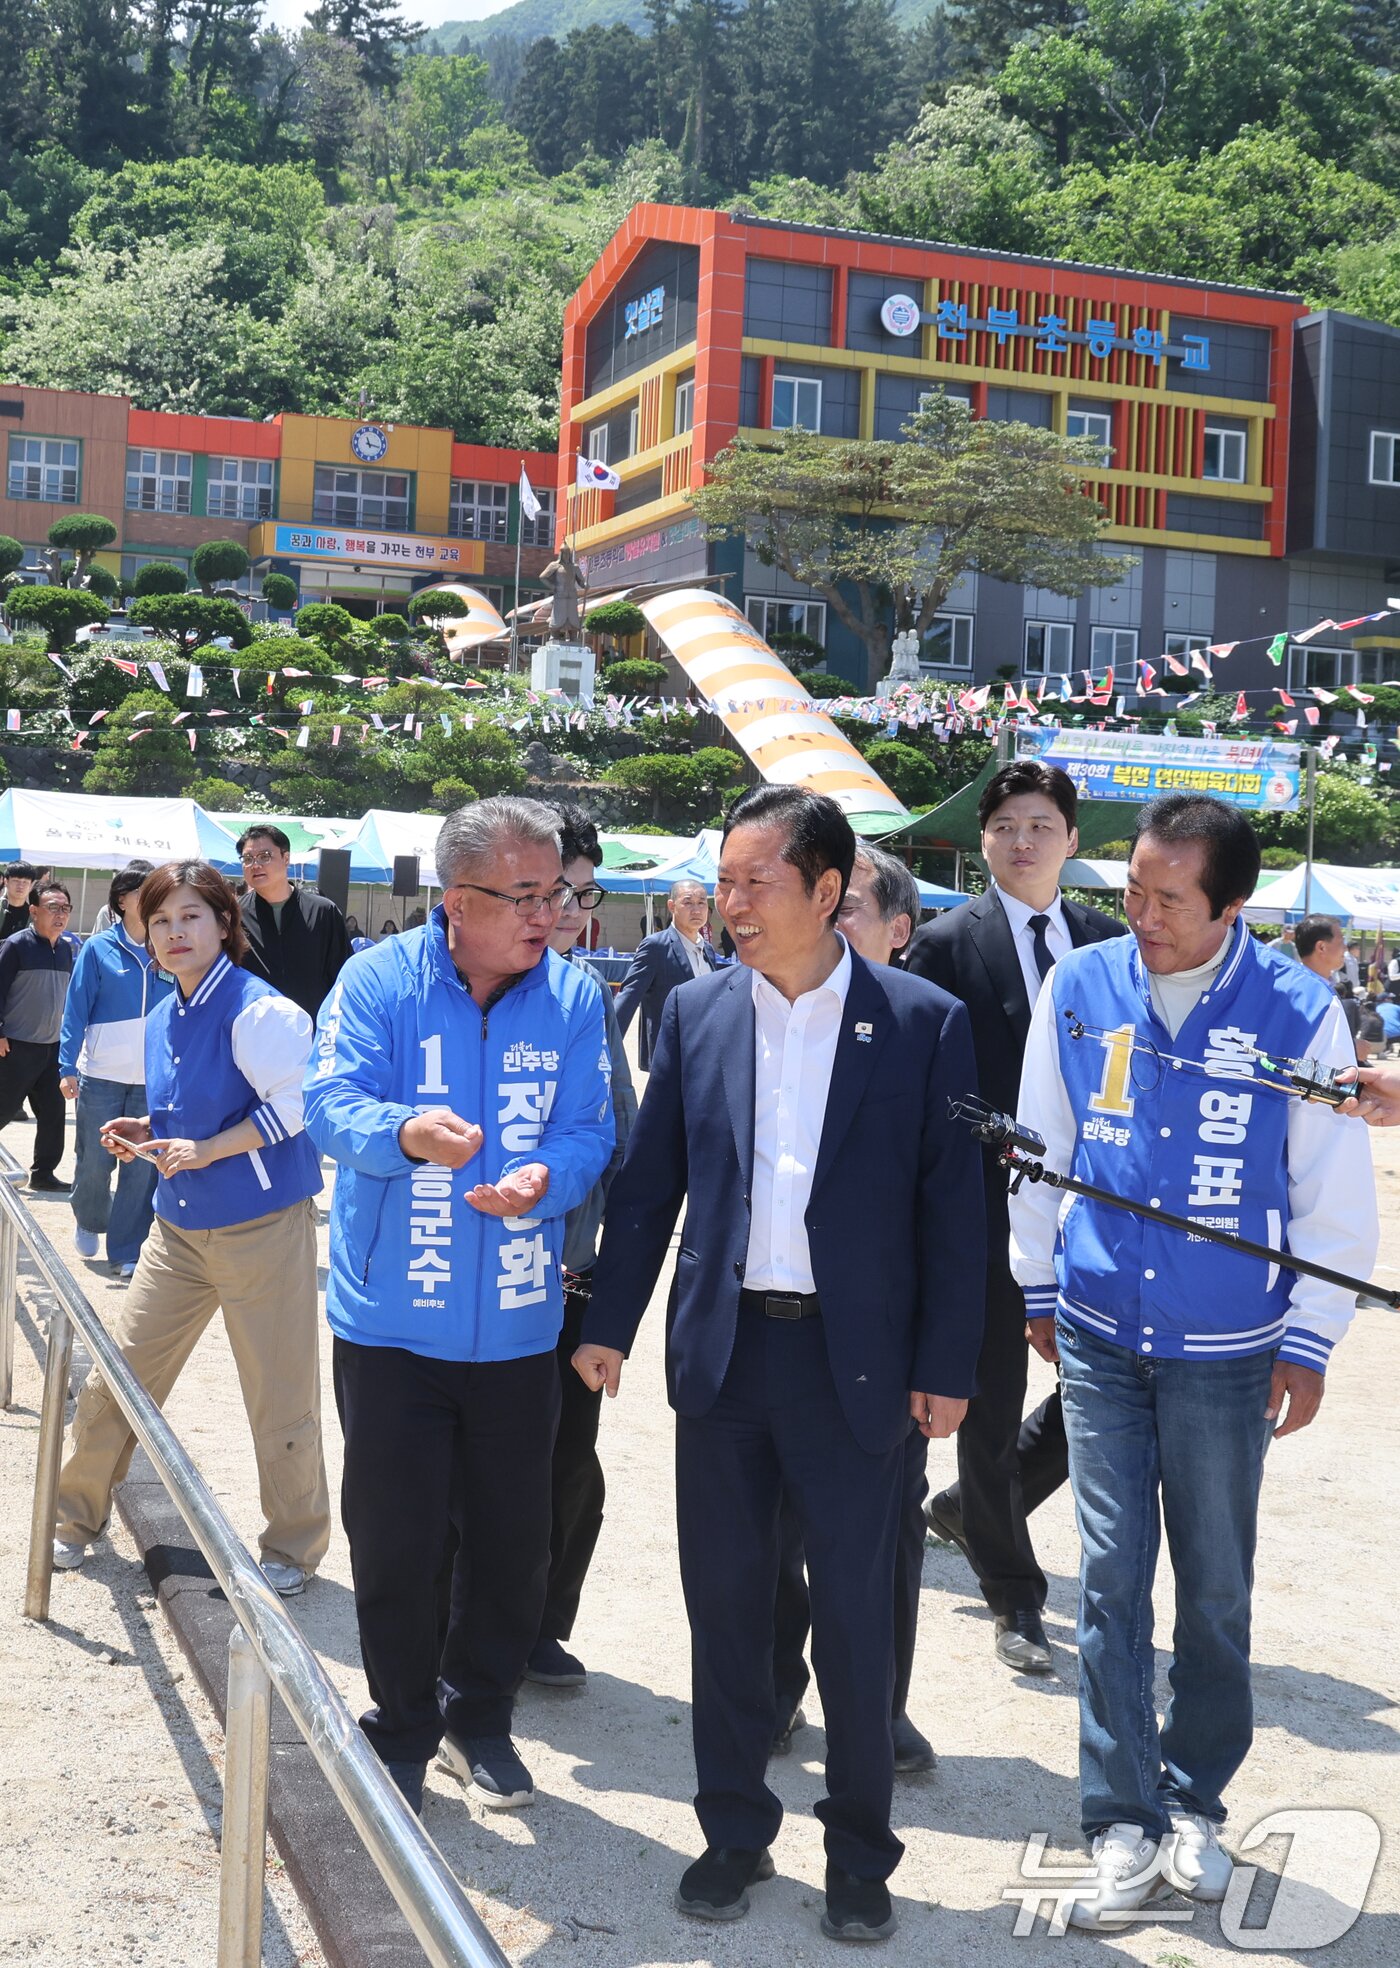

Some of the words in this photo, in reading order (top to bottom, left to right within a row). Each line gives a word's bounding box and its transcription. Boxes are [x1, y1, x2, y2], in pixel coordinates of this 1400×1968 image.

[937, 299, 1210, 370] 천부초등학교
[290, 533, 312, 547] 꿈과
[316, 535, 342, 551] 사랑,
[345, 538, 377, 553] 행복을
[380, 542, 411, 557] 가꾸는
[415, 545, 435, 560] 천부
[439, 547, 460, 562] 교육
[1066, 761, 1110, 778] 제30회
[1112, 765, 1151, 788] 북면
[1154, 766, 1263, 795] 면민체육대회
[1274, 782, 1284, 796] 축
[502, 1049, 560, 1073] 민주당
[510, 1040, 533, 1051] 더불어
[416, 1033, 449, 1094] 1
[1087, 1023, 1136, 1118] 1
[1187, 1026, 1258, 1206] 홍영표
[1082, 1121, 1132, 1147] 민주당
[407, 1104, 453, 1293] 릉군수
[496, 1080, 559, 1310] 정환
[412, 1298, 445, 1309] 예비후보
